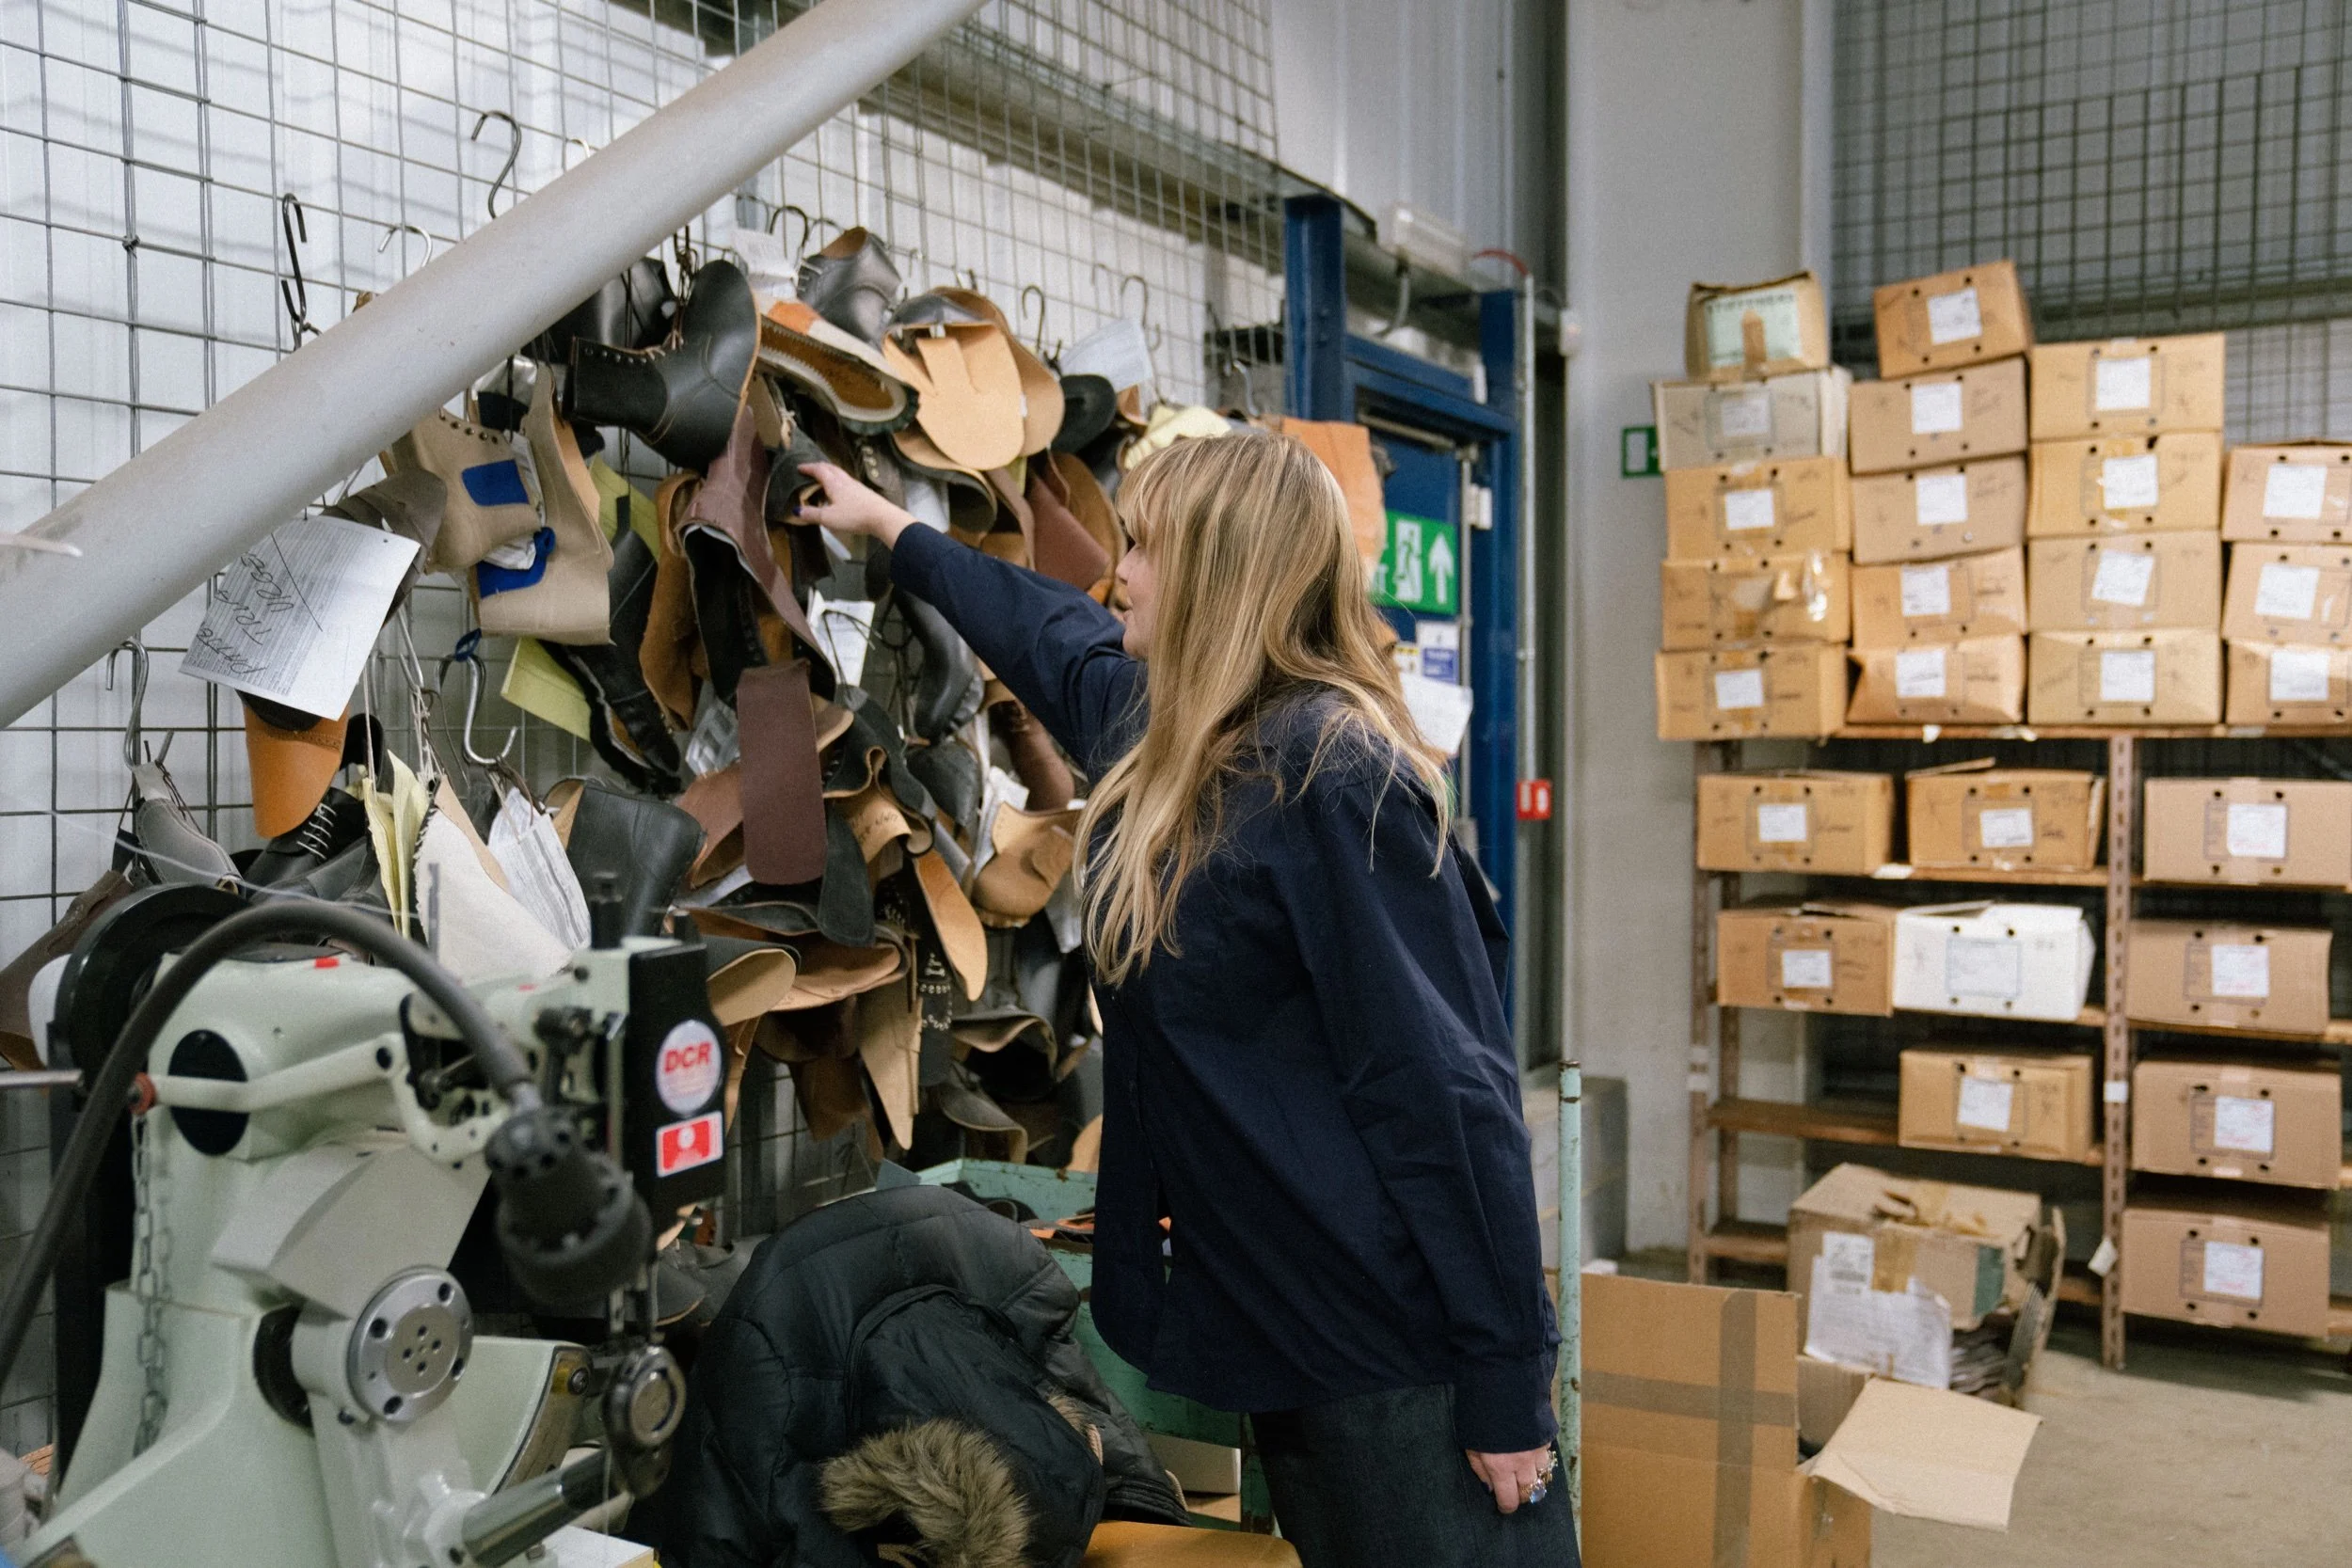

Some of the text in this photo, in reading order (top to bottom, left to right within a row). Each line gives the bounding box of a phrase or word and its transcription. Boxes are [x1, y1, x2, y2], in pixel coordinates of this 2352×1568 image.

[241, 553, 294, 612] URGE
[196, 622, 269, 674] PATTE
[665, 1042, 711, 1073] DCR
